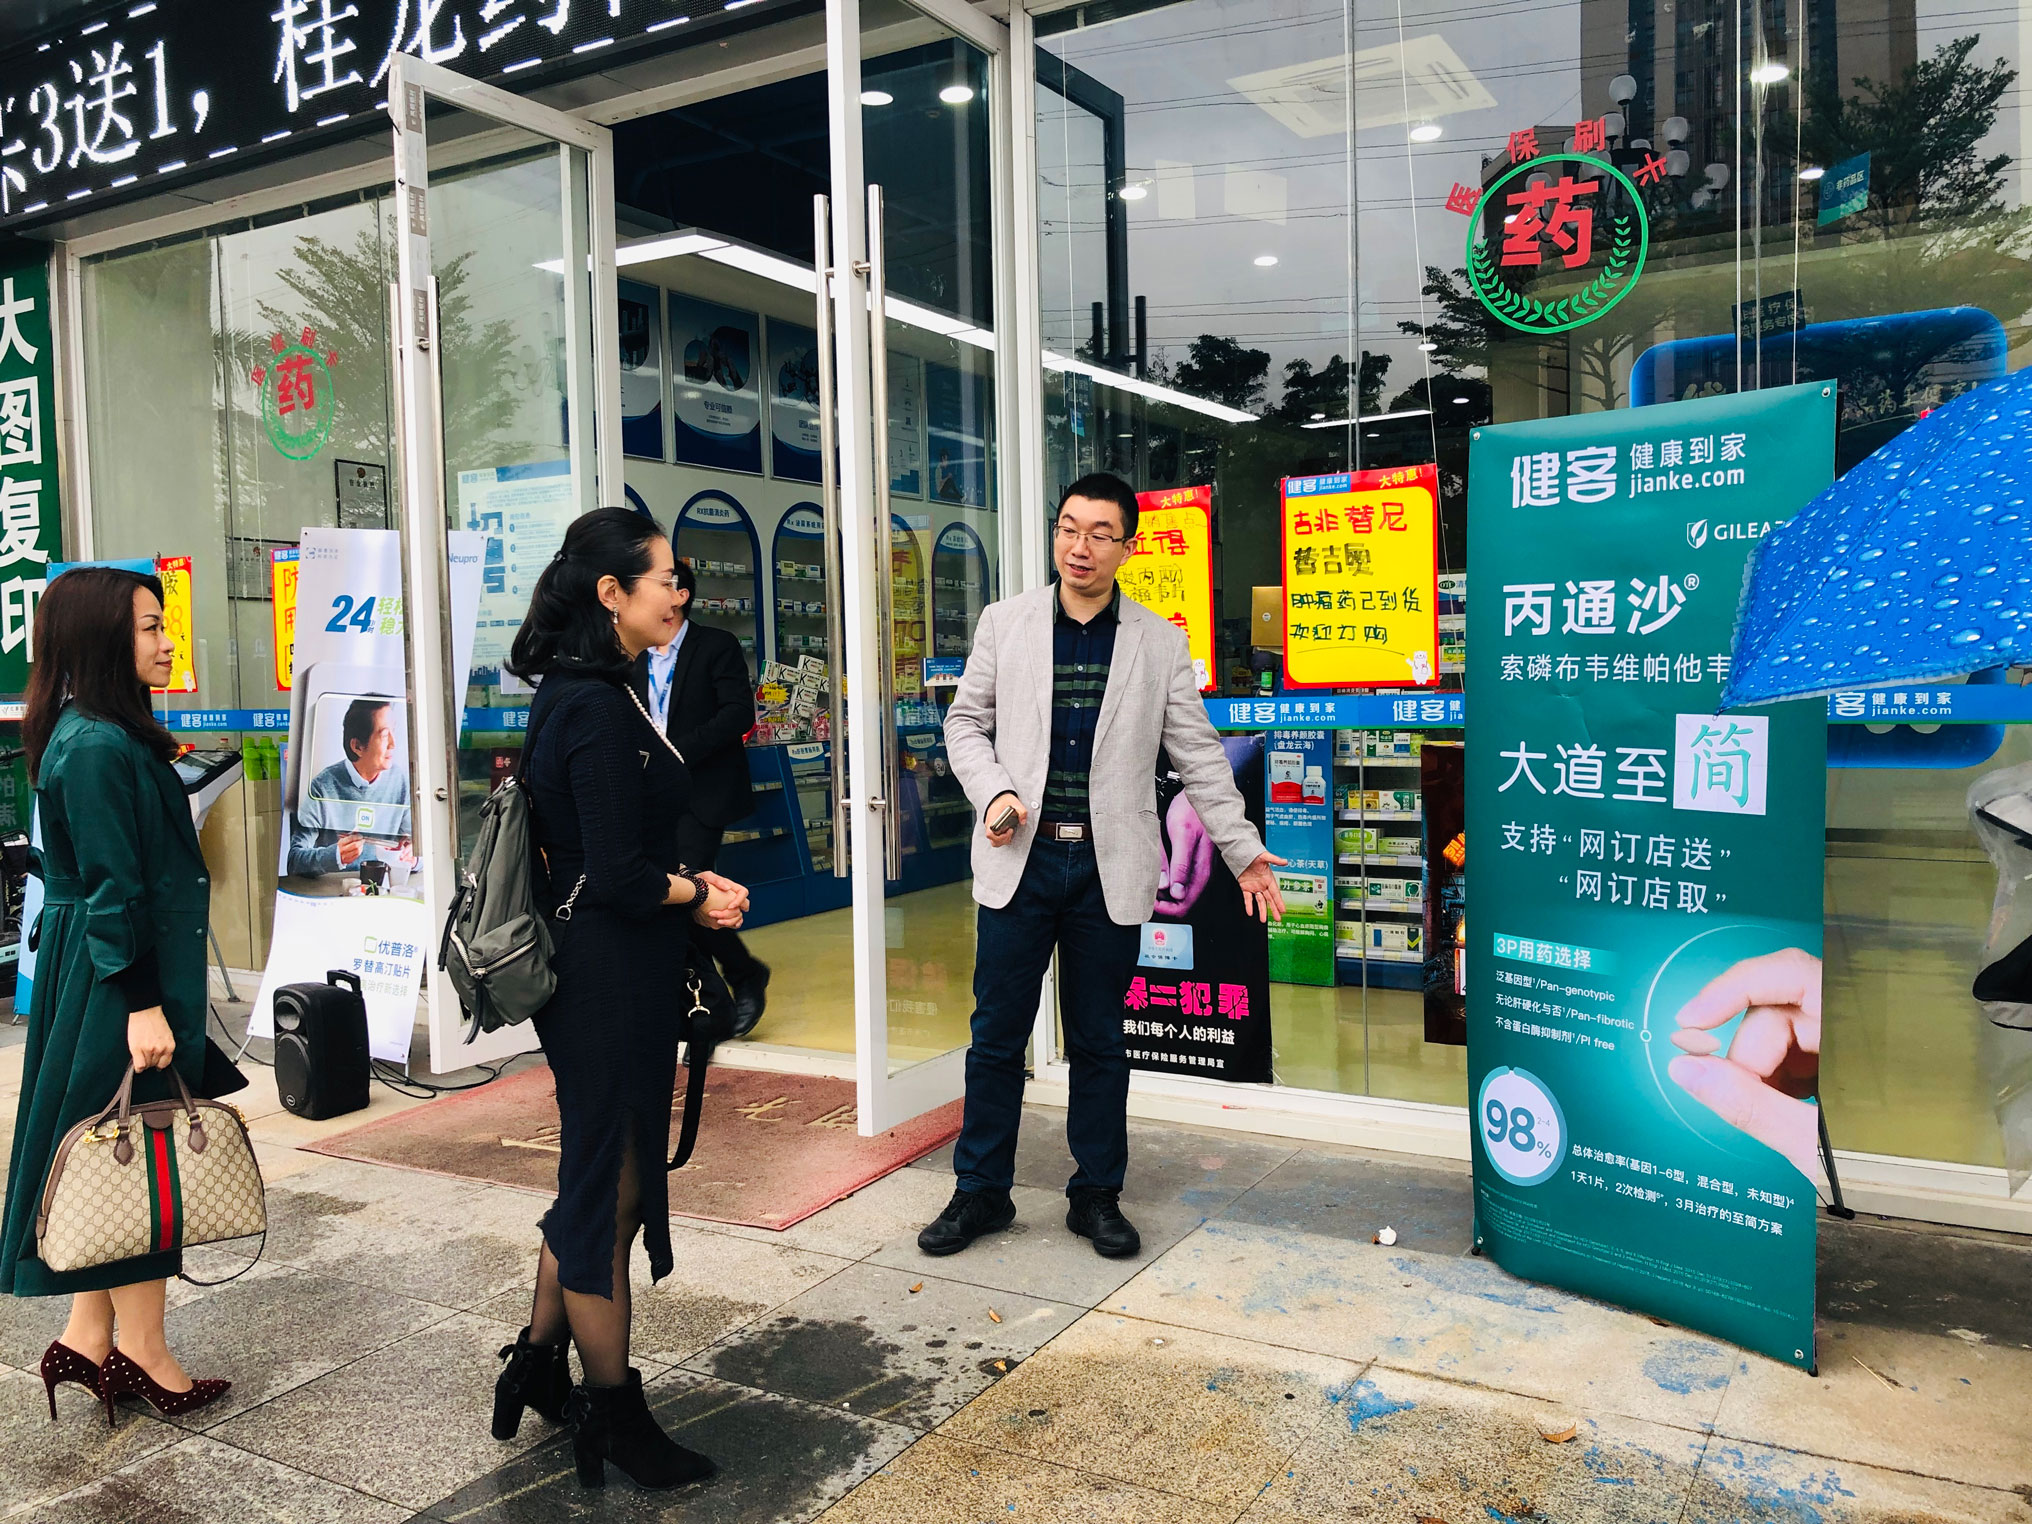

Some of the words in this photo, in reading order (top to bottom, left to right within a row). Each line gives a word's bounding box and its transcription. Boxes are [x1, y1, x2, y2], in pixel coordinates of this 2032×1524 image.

[1445, 118, 1668, 217] 医保刷卡
[1500, 176, 1599, 269] 药
[276, 355, 315, 416] 药
[1630, 432, 1746, 472] 健康到家
[0, 277, 50, 663] 大图复印
[1510, 445, 1618, 509] 健客
[1288, 479, 1317, 494] 健客
[1629, 467, 1745, 499] jianke.com
[1714, 520, 1785, 541] GILEA
[325, 595, 376, 633] 24
[1280, 702, 1336, 713] 健康到家
[1872, 692, 1952, 705] 健康到家
[181, 713, 202, 728] 健客
[253, 713, 275, 728] 健客
[1229, 702, 1276, 724] 健客
[1280, 713, 1336, 724] jianke.com
[1393, 700, 1444, 722] 健客
[1872, 705, 1952, 717] jianke.com
[1498, 721, 1754, 809] 大道至简
[1496, 938, 1592, 970] 3P用药选择
[1123, 1019, 1236, 1045] 我们每个人的利益
[1594, 1037, 1615, 1051] free
